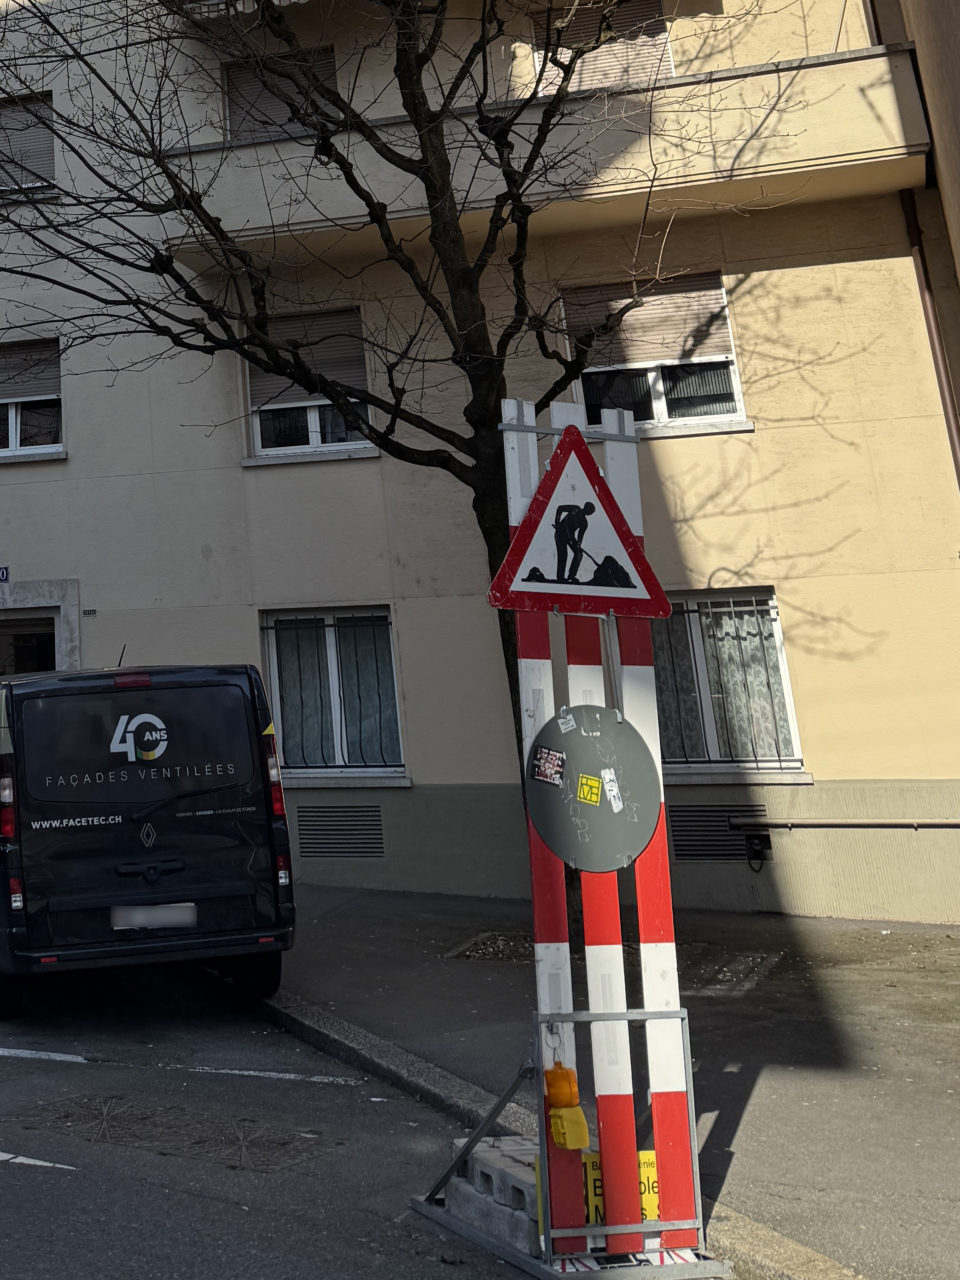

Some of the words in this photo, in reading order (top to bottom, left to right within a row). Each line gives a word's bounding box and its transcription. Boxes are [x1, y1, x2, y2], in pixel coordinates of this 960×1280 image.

[110, 713, 168, 762] 40
[144, 730, 167, 741] ANS
[46, 770, 129, 787] FAÇADES
[138, 763, 236, 780] VENTILÉES
[31, 815, 123, 830] WWW.FACETEC.CH
